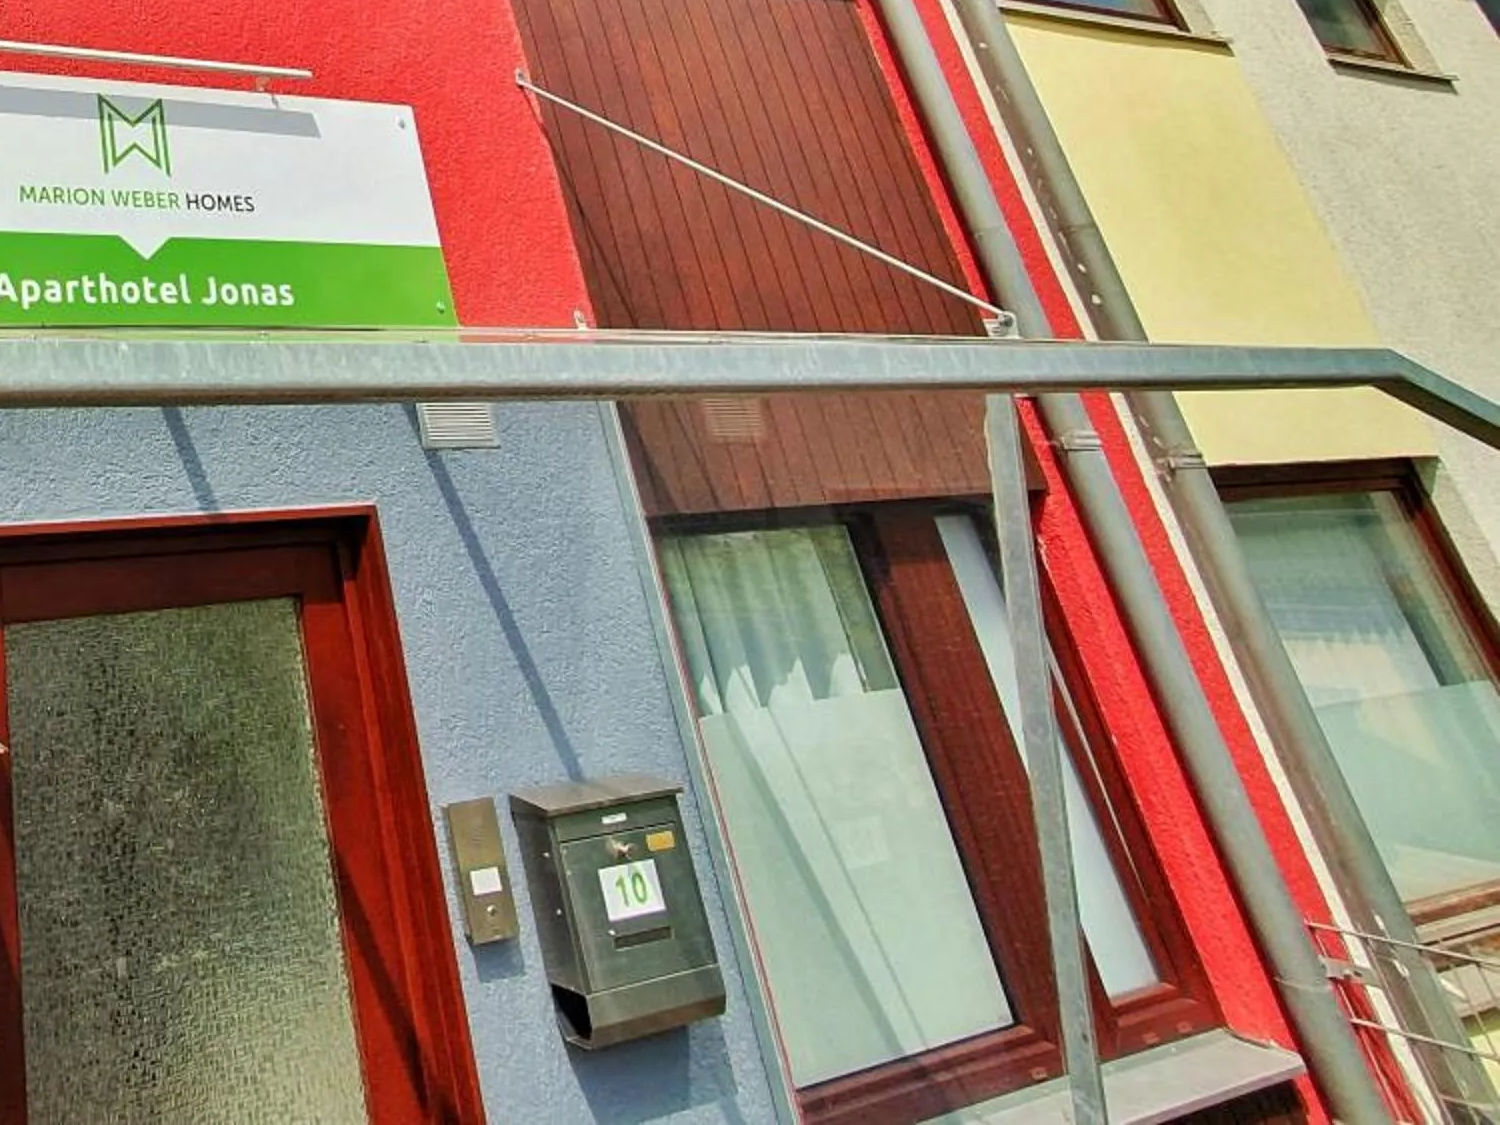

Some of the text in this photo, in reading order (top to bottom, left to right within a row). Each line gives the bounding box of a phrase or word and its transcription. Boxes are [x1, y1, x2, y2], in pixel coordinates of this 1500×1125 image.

[18, 184, 256, 213] MARION WEBER HOMES
[202, 276, 296, 307] Jonas
[615, 871, 648, 908] 10
